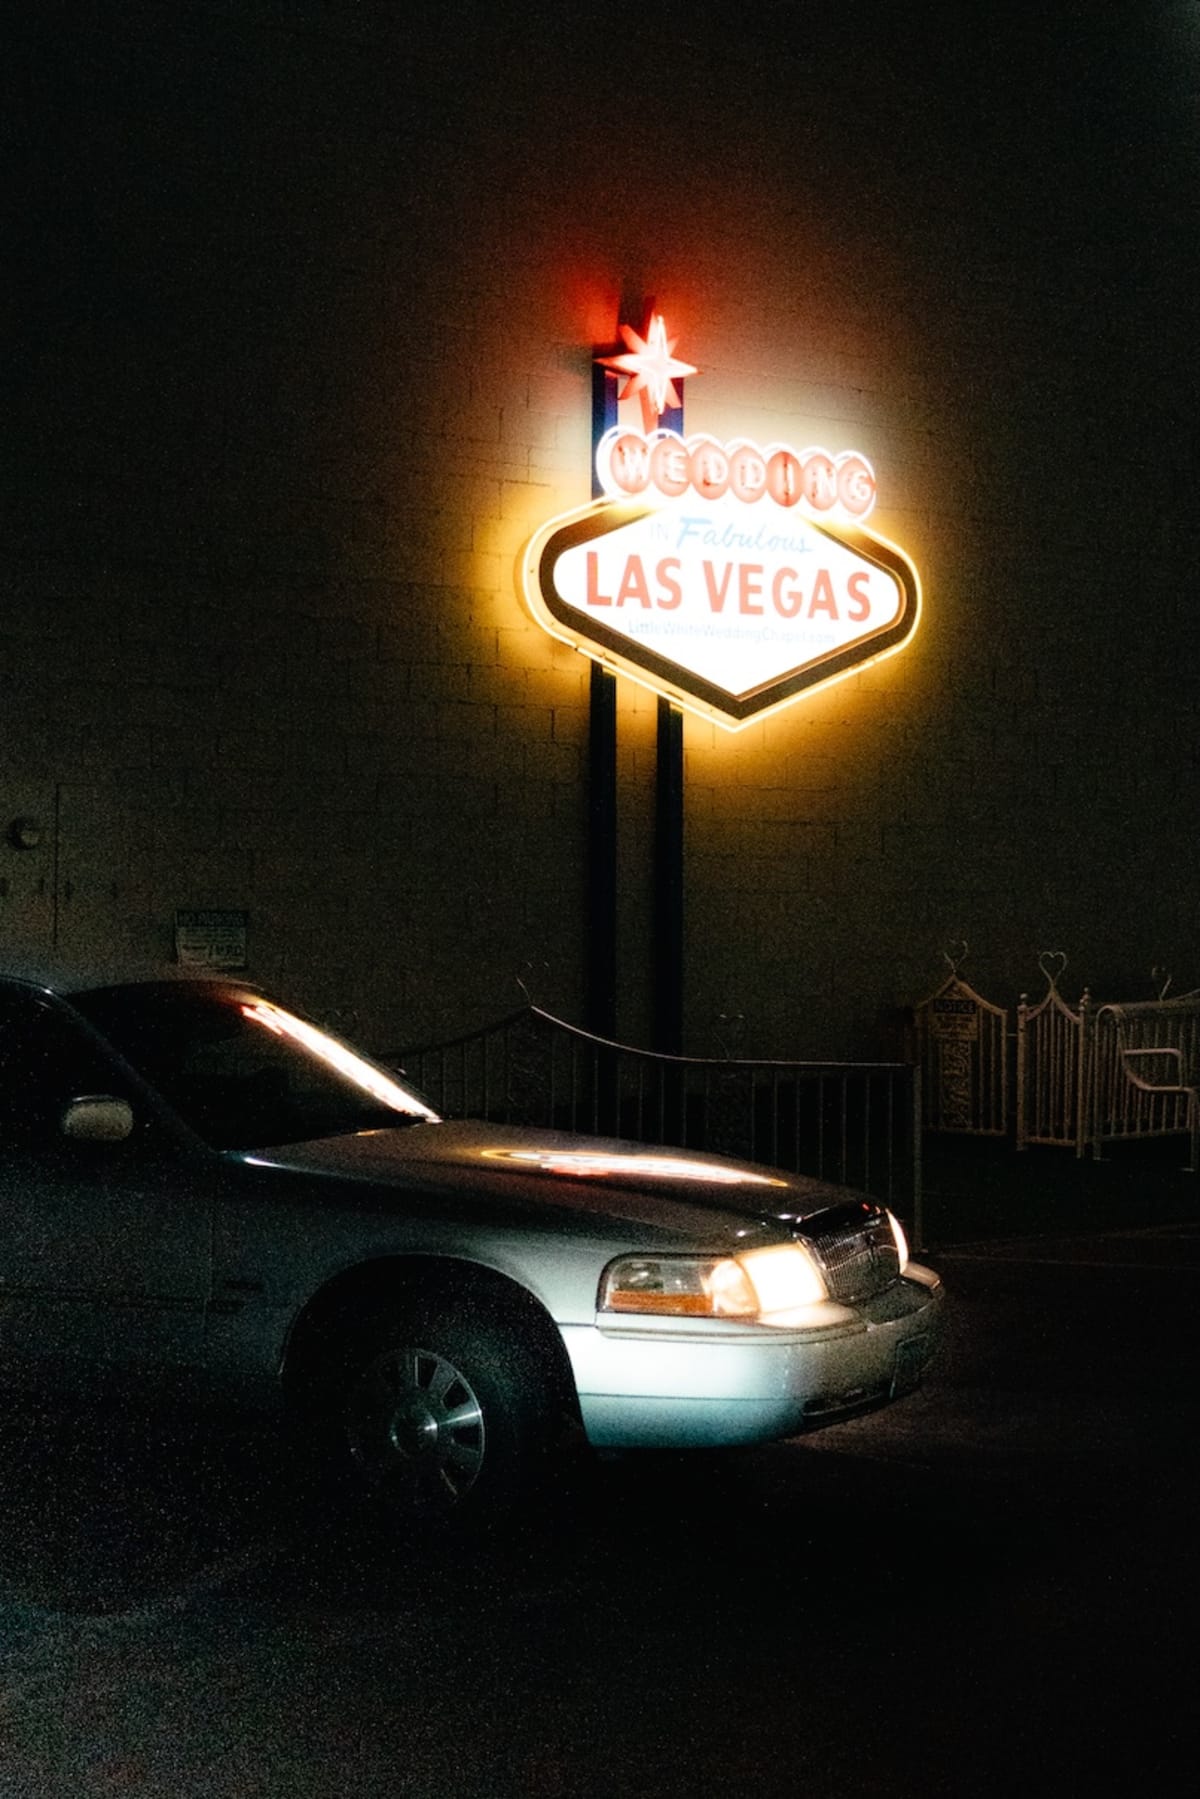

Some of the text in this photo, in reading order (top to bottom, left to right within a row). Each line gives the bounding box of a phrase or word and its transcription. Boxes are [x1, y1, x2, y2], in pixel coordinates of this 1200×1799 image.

[615, 443, 874, 504] WEDDING
[676, 515, 816, 554] Fabulous
[585, 551, 872, 623] LAS VEGAS
[935, 1000, 975, 1013] NOTICE
